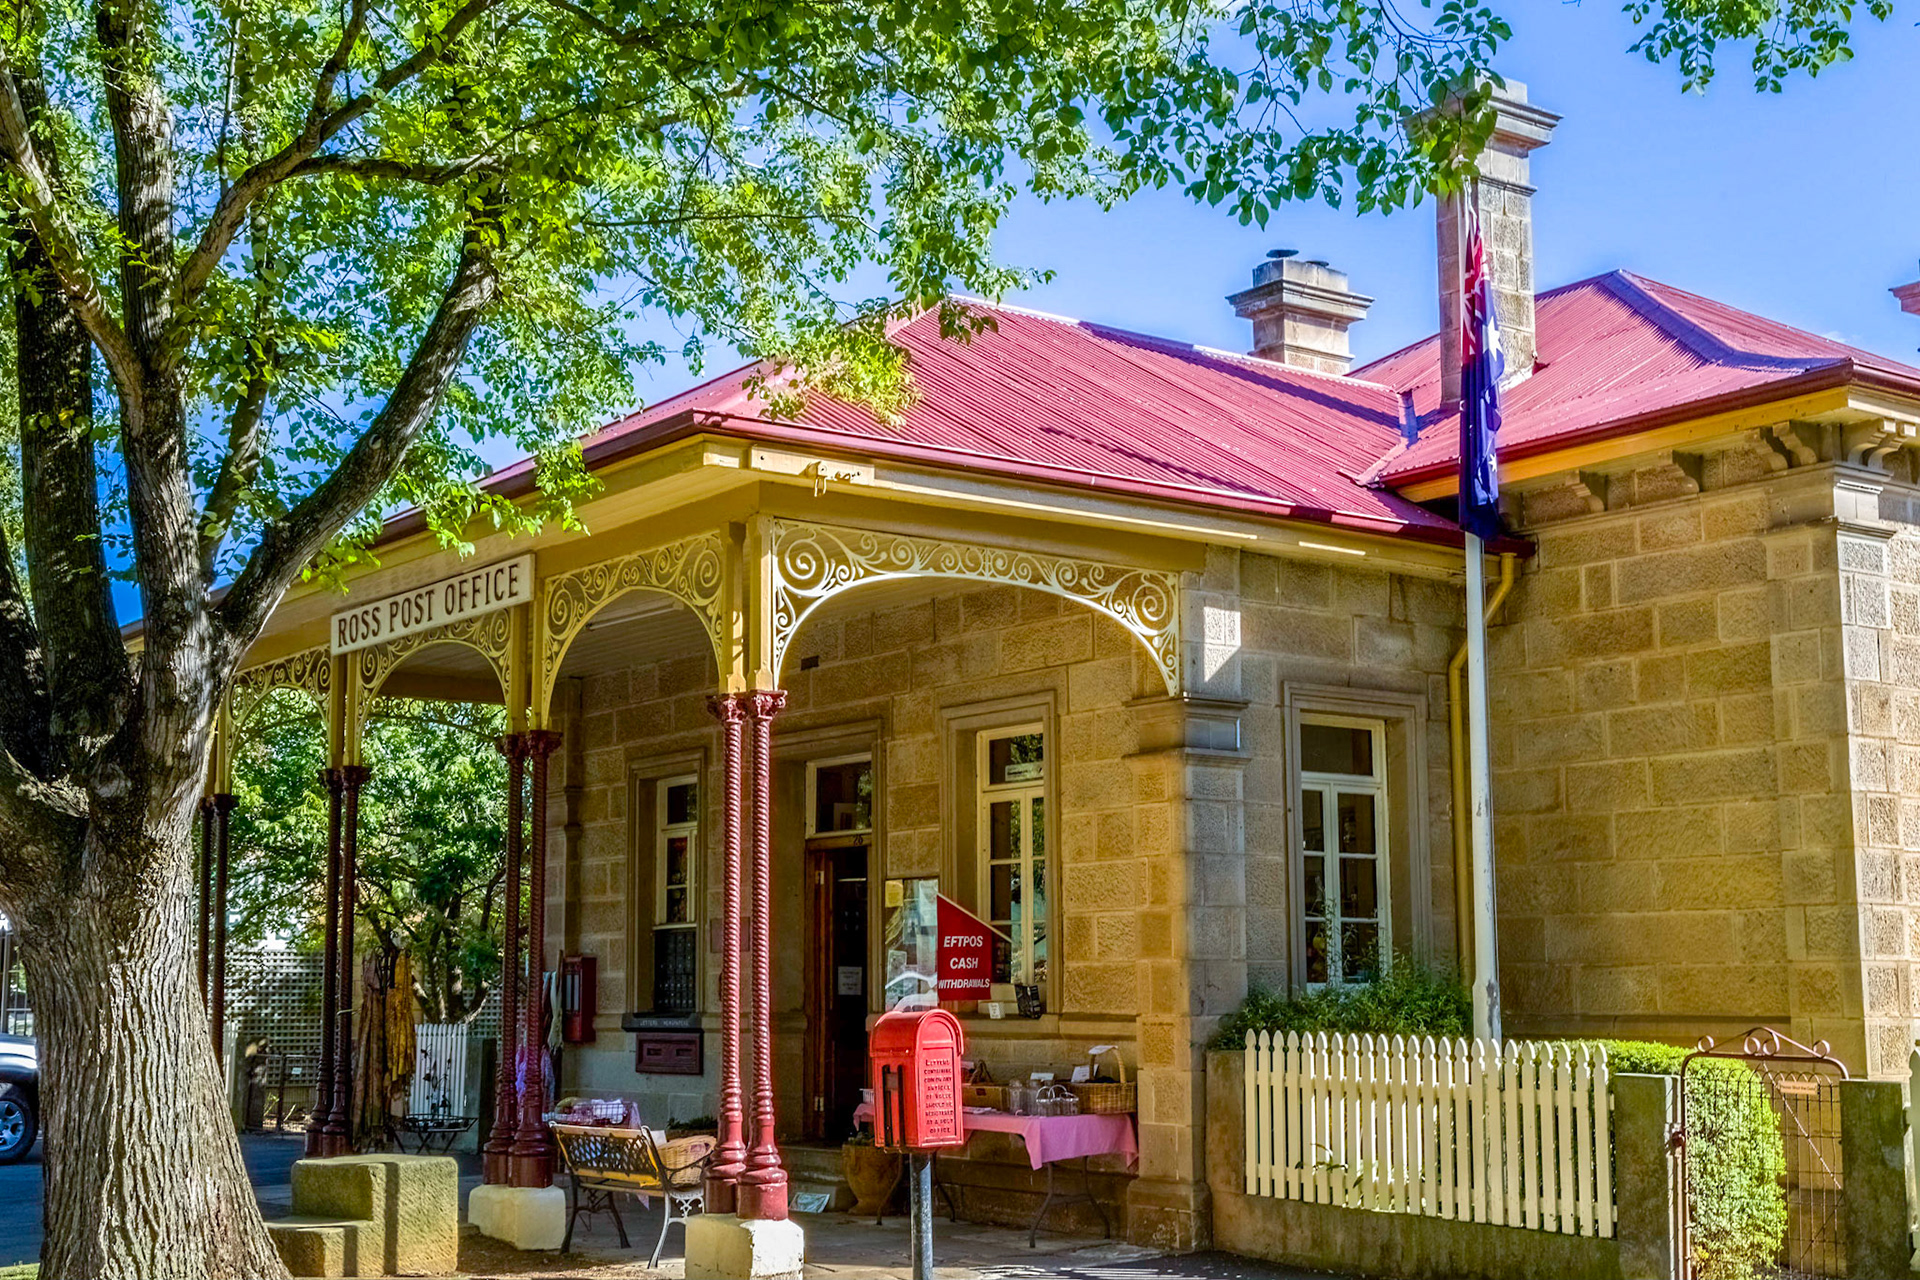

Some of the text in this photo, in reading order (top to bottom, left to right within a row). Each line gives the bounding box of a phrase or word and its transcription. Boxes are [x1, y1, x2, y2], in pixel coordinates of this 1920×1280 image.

[337, 563, 519, 648] ROSS POST OFFICE
[943, 935, 983, 947] EFTPOS
[950, 957, 979, 969] CASH
[938, 978, 990, 989] WITHDRAWALS
